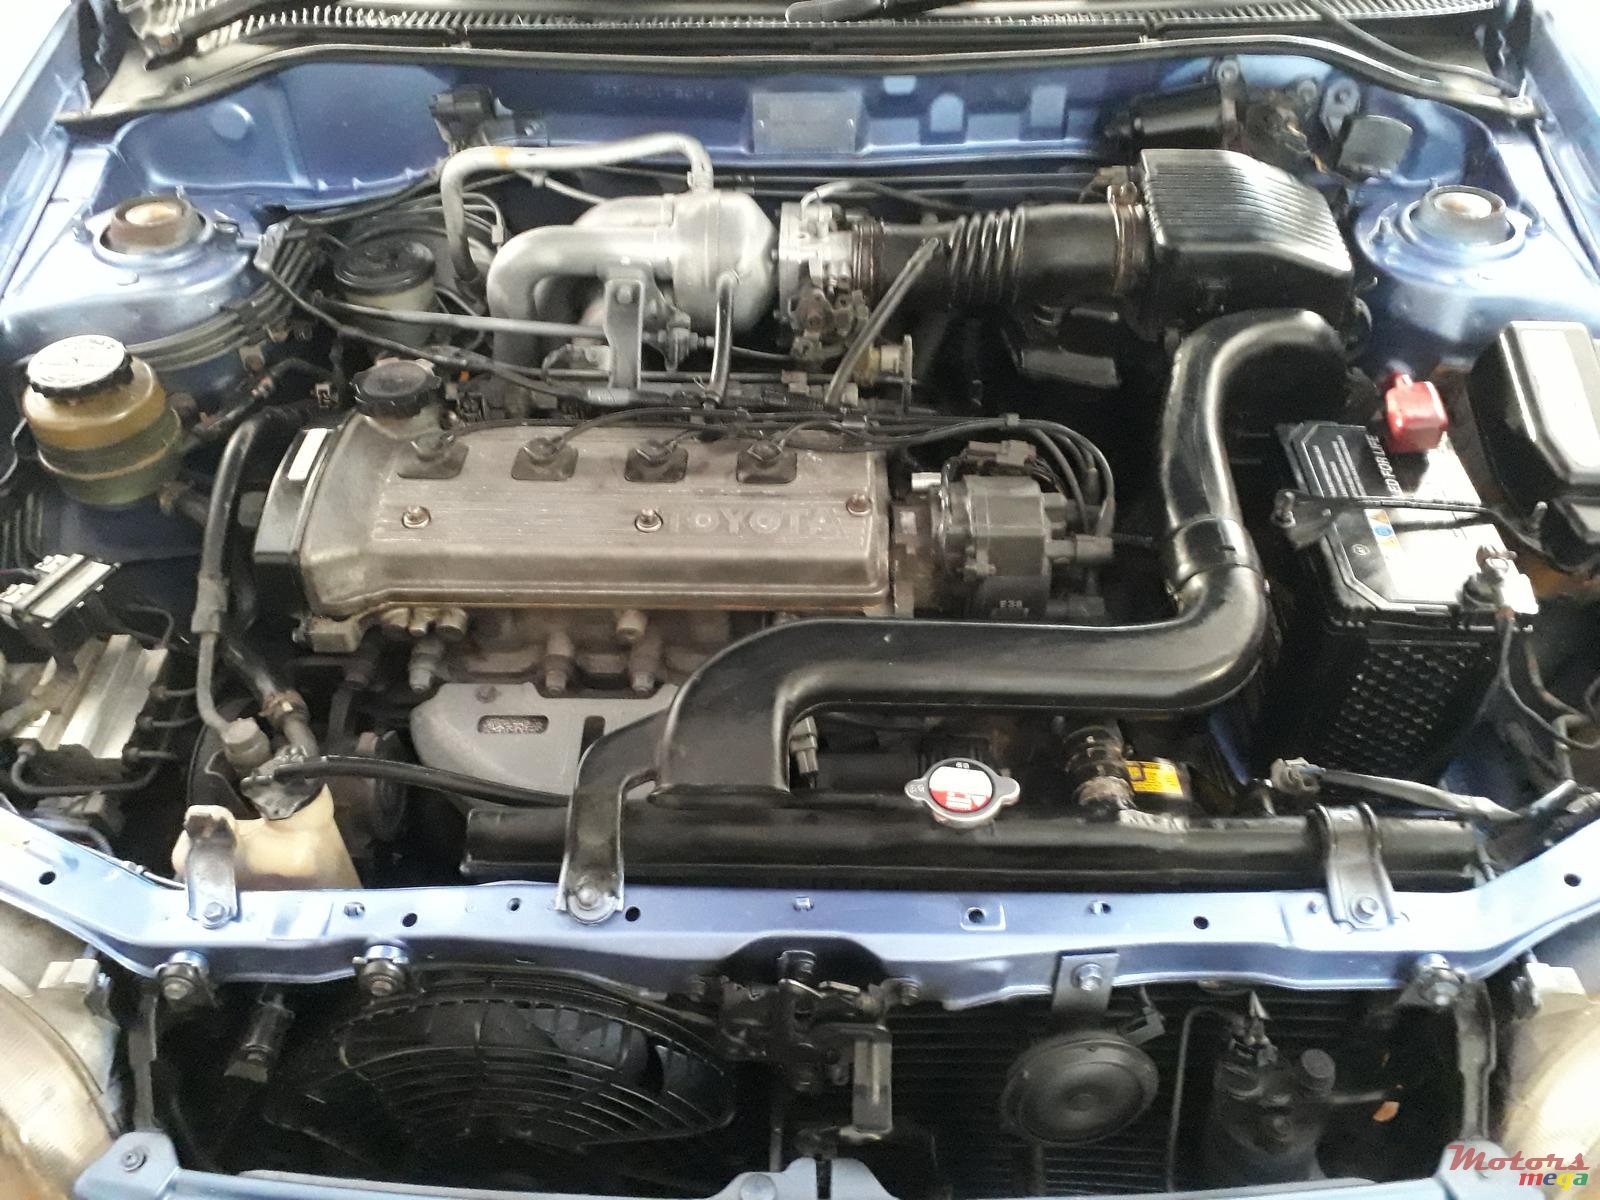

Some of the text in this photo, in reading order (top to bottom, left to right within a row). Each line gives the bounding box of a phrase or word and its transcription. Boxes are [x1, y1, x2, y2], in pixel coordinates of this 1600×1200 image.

[1365, 433, 1386, 457] LIFE
[1375, 456, 1396, 479] FOR
[664, 505, 845, 535] TOYOTA
